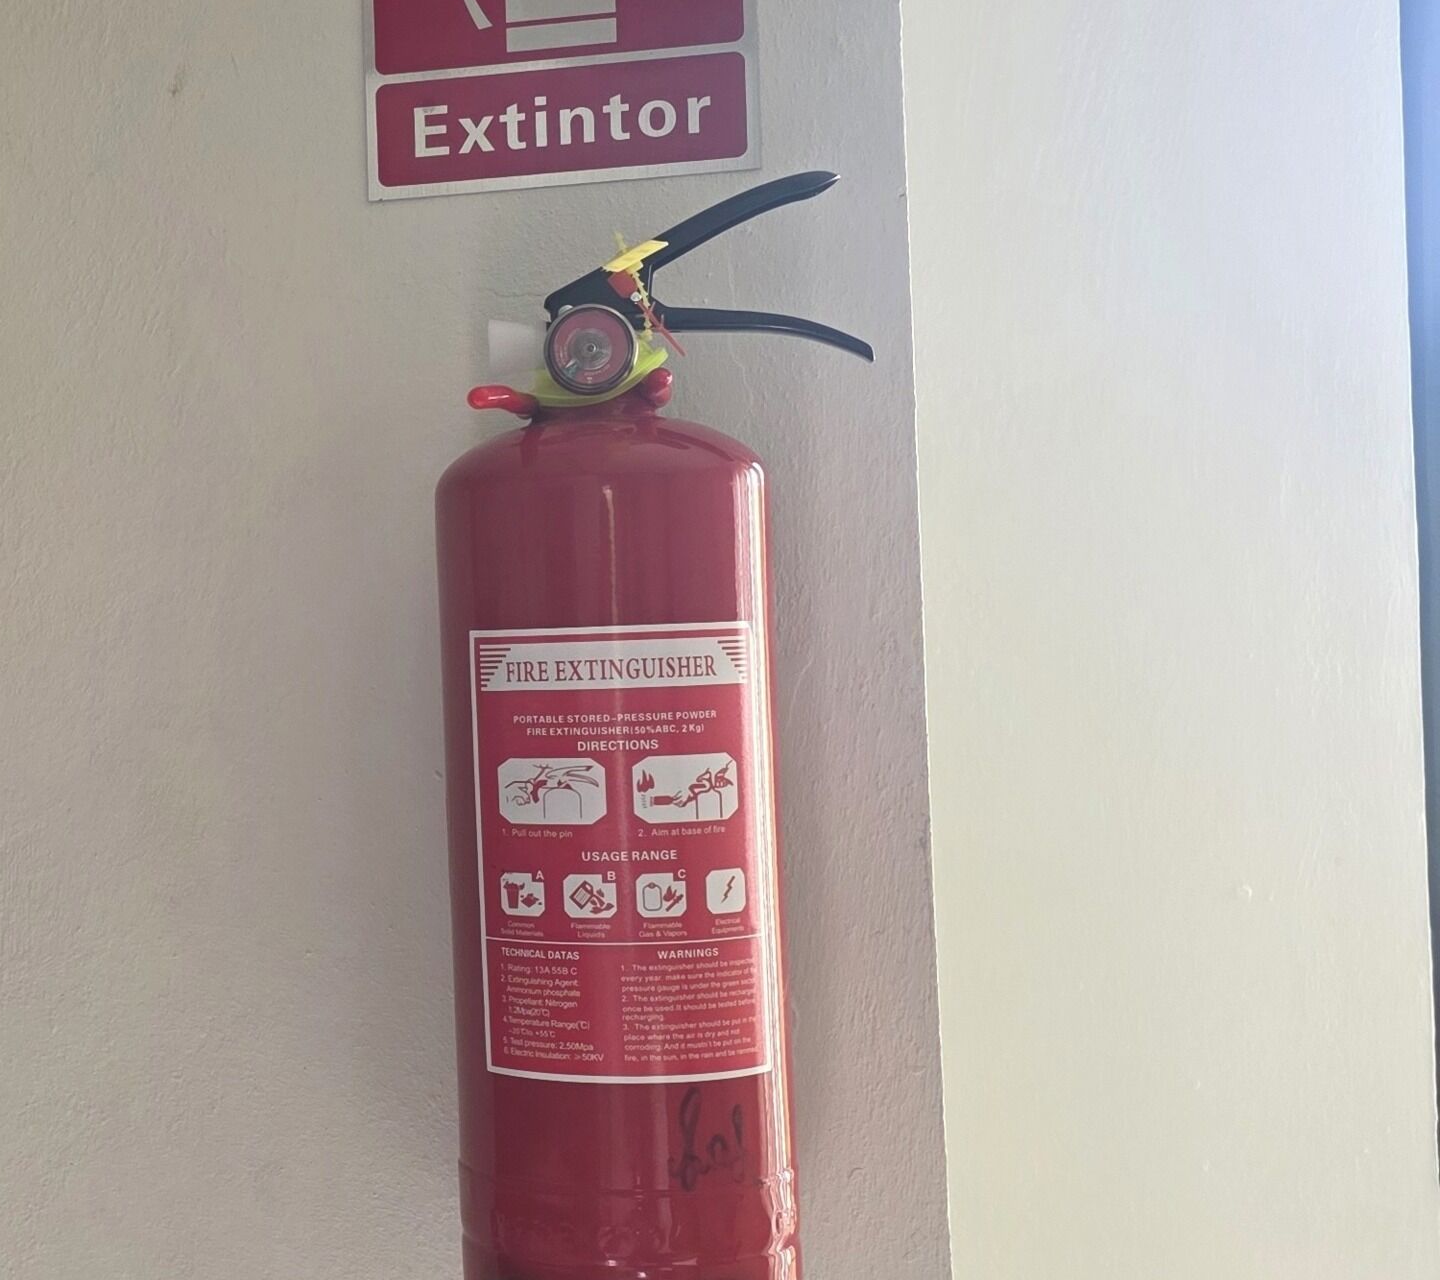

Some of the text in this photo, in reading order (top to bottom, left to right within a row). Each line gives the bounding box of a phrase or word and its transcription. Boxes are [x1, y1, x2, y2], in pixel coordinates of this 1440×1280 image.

[412, 92, 711, 159] Extintor
[506, 655, 717, 682] FIRE EXTINGUISHER
[513, 710, 717, 724] PORTABLE STORED-PRESSURE POWDER
[527, 727, 547, 736] FIRE
[577, 739, 659, 751] DIRECTIONS
[511, 828, 527, 837] Pull
[543, 829, 557, 838] the
[559, 830, 573, 839] pin
[638, 825, 725, 837] 2. Aim at base of fire
[581, 849, 678, 861] USAGE RANGE
[535, 870, 544, 880] A
[607, 871, 616, 881] B
[677, 868, 687, 878] C
[570, 922, 611, 930] Flammable
[643, 921, 682, 929] Flammable
[639, 929, 687, 938] Gas & Vapors
[501, 947, 580, 961] TECHNICAL DATAS
[657, 947, 719, 959] WARNINGS
[535, 966, 551, 974] 13A
[552, 967, 568, 975] 55B
[570, 967, 578, 975] C
[648, 963, 694, 972] extinguisher
[696, 961, 718, 969] should
[507, 975, 553, 988] Extinguishing
[621, 975, 643, 983] every
[543, 988, 580, 998] phosphate
[621, 985, 655, 993] pressure
[689, 982, 709, 990] under
[649, 993, 695, 1003] extinguisher
[697, 992, 718, 1000] should
[545, 999, 578, 1010] Nitrogen
[683, 1003, 707, 1011] should
[651, 1022, 697, 1031] extinguisher
[698, 1020, 721, 1028] should
[731, 1018, 741, 1026] put
[510, 1037, 524, 1046] Test
[623, 1034, 645, 1042] place
[647, 1033, 670, 1041] where
[704, 1030, 715, 1038] dry
[722, 1039, 732, 1047] put
[581, 1053, 604, 1062] 50KV
